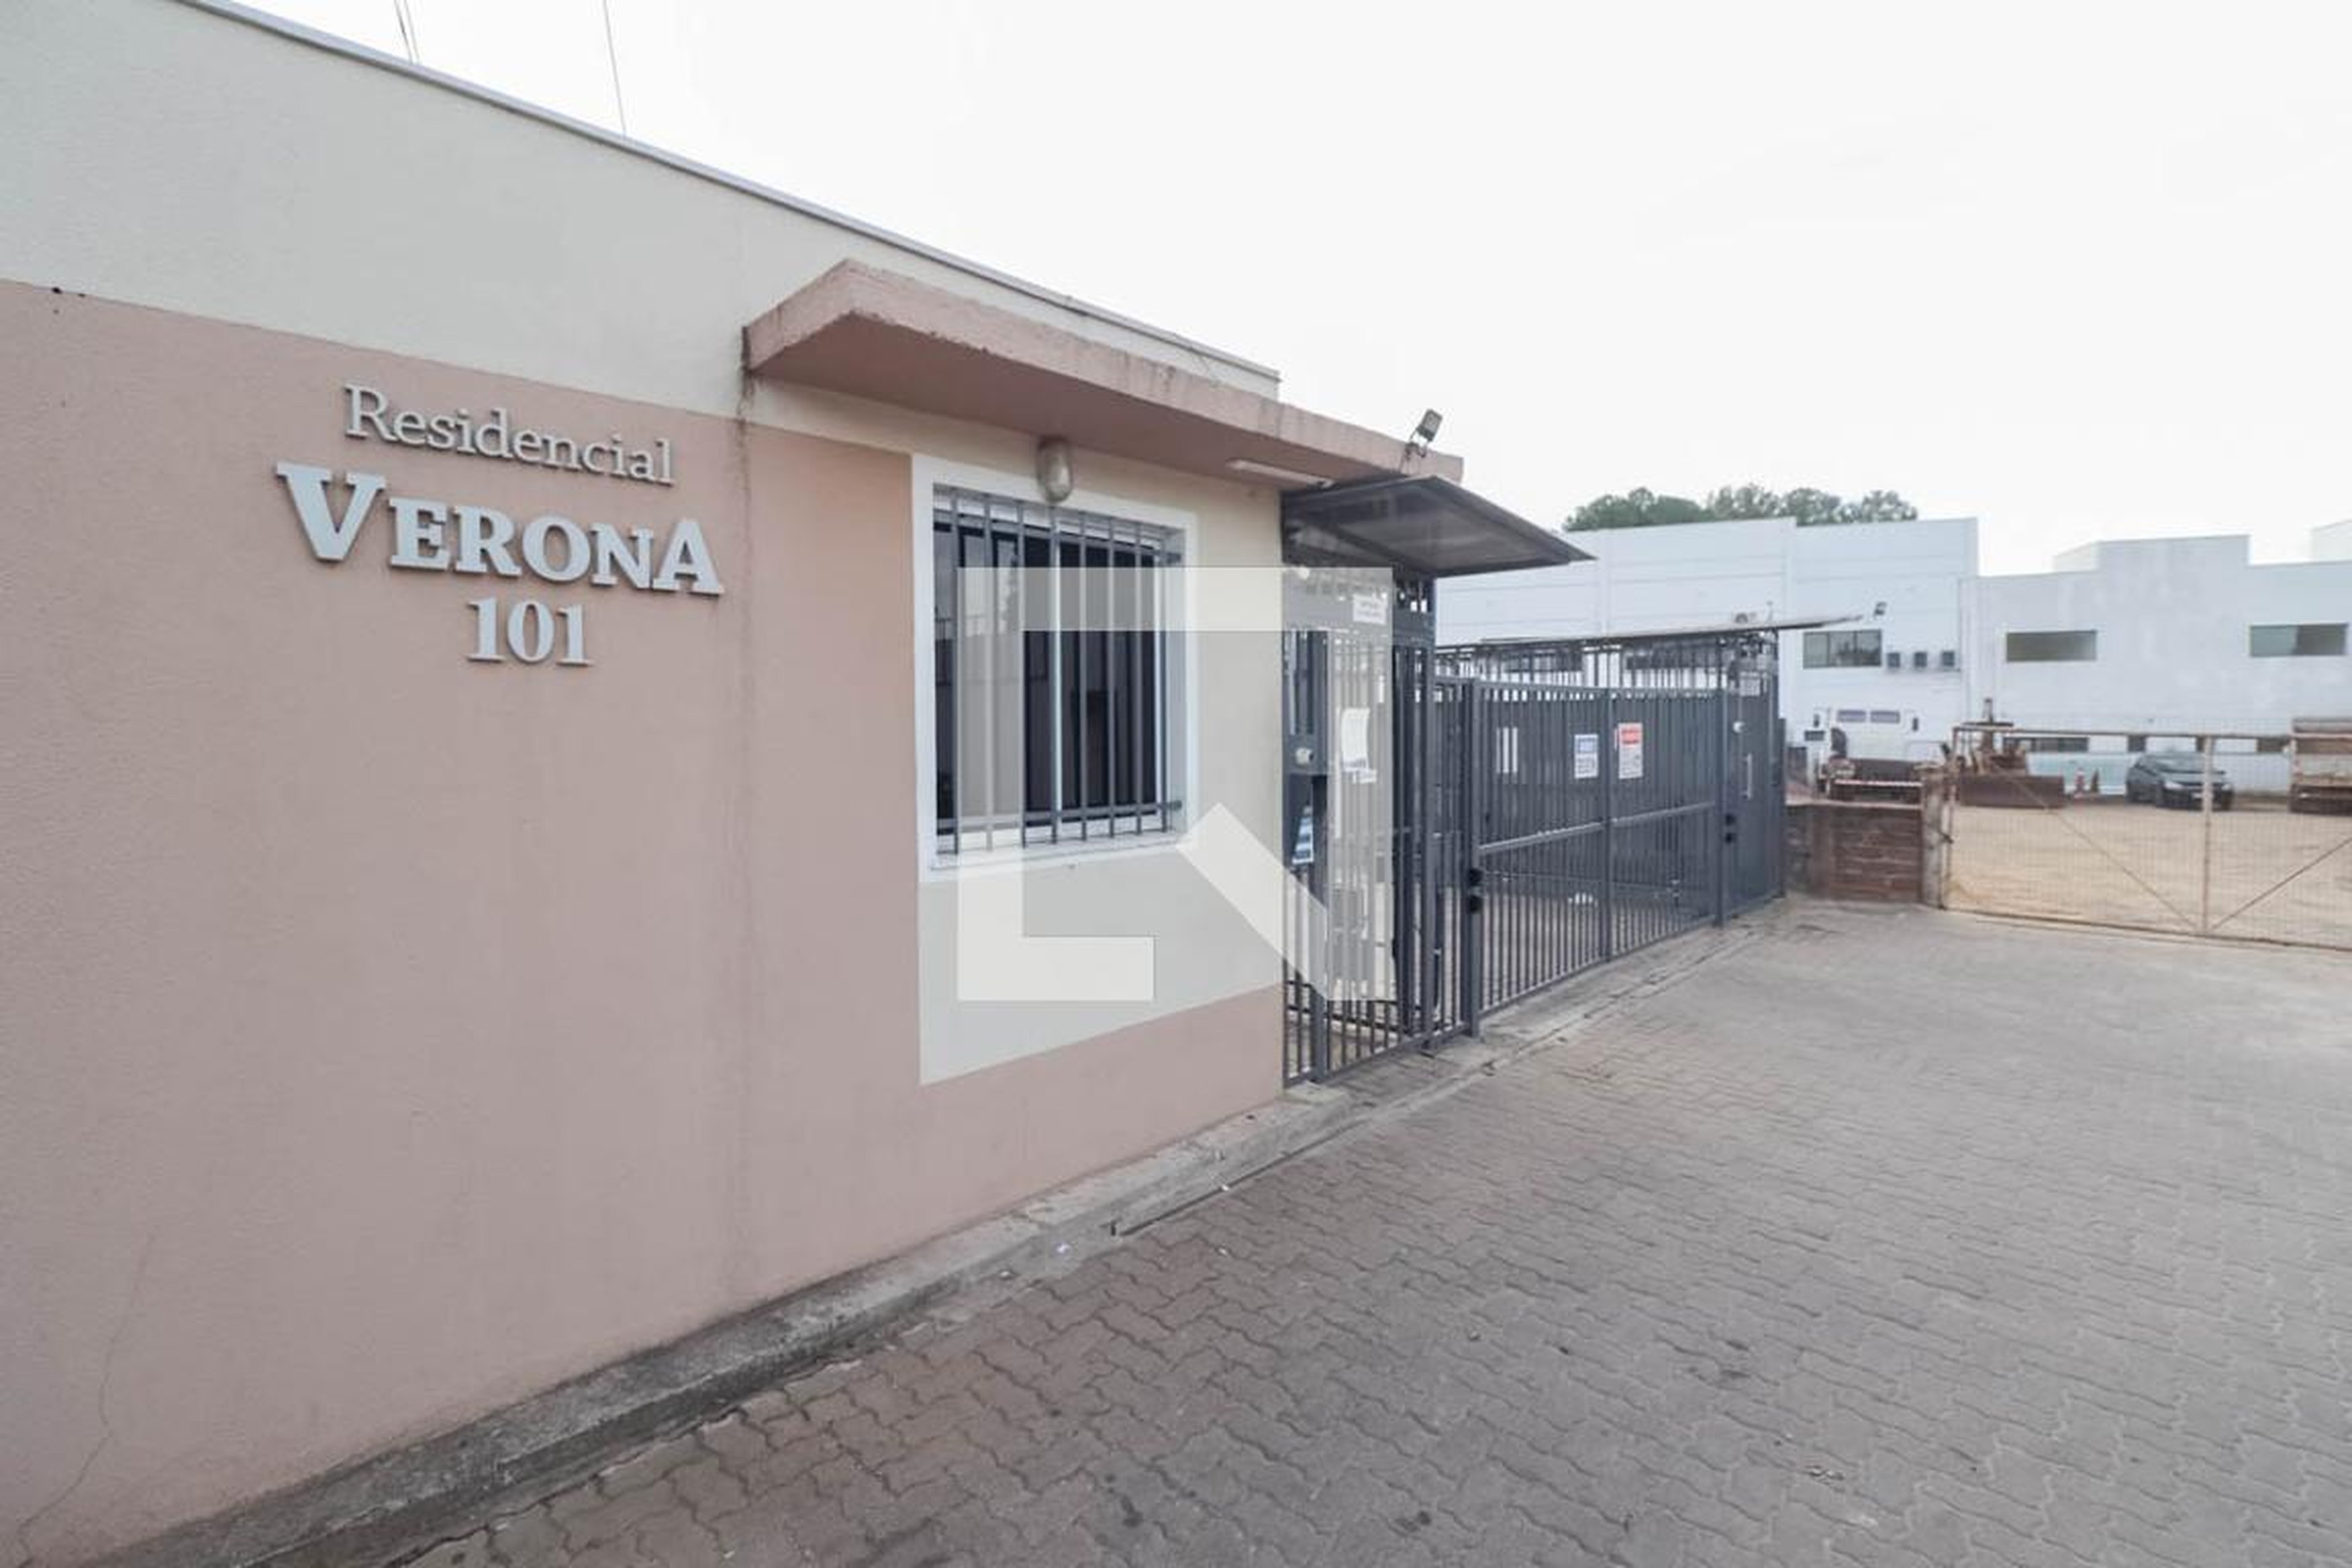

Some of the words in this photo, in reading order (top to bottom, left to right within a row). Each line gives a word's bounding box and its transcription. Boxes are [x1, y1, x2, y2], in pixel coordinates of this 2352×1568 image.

[344, 382, 676, 486] Residencial
[276, 461, 725, 596] VERONA
[467, 596, 592, 666] 101
